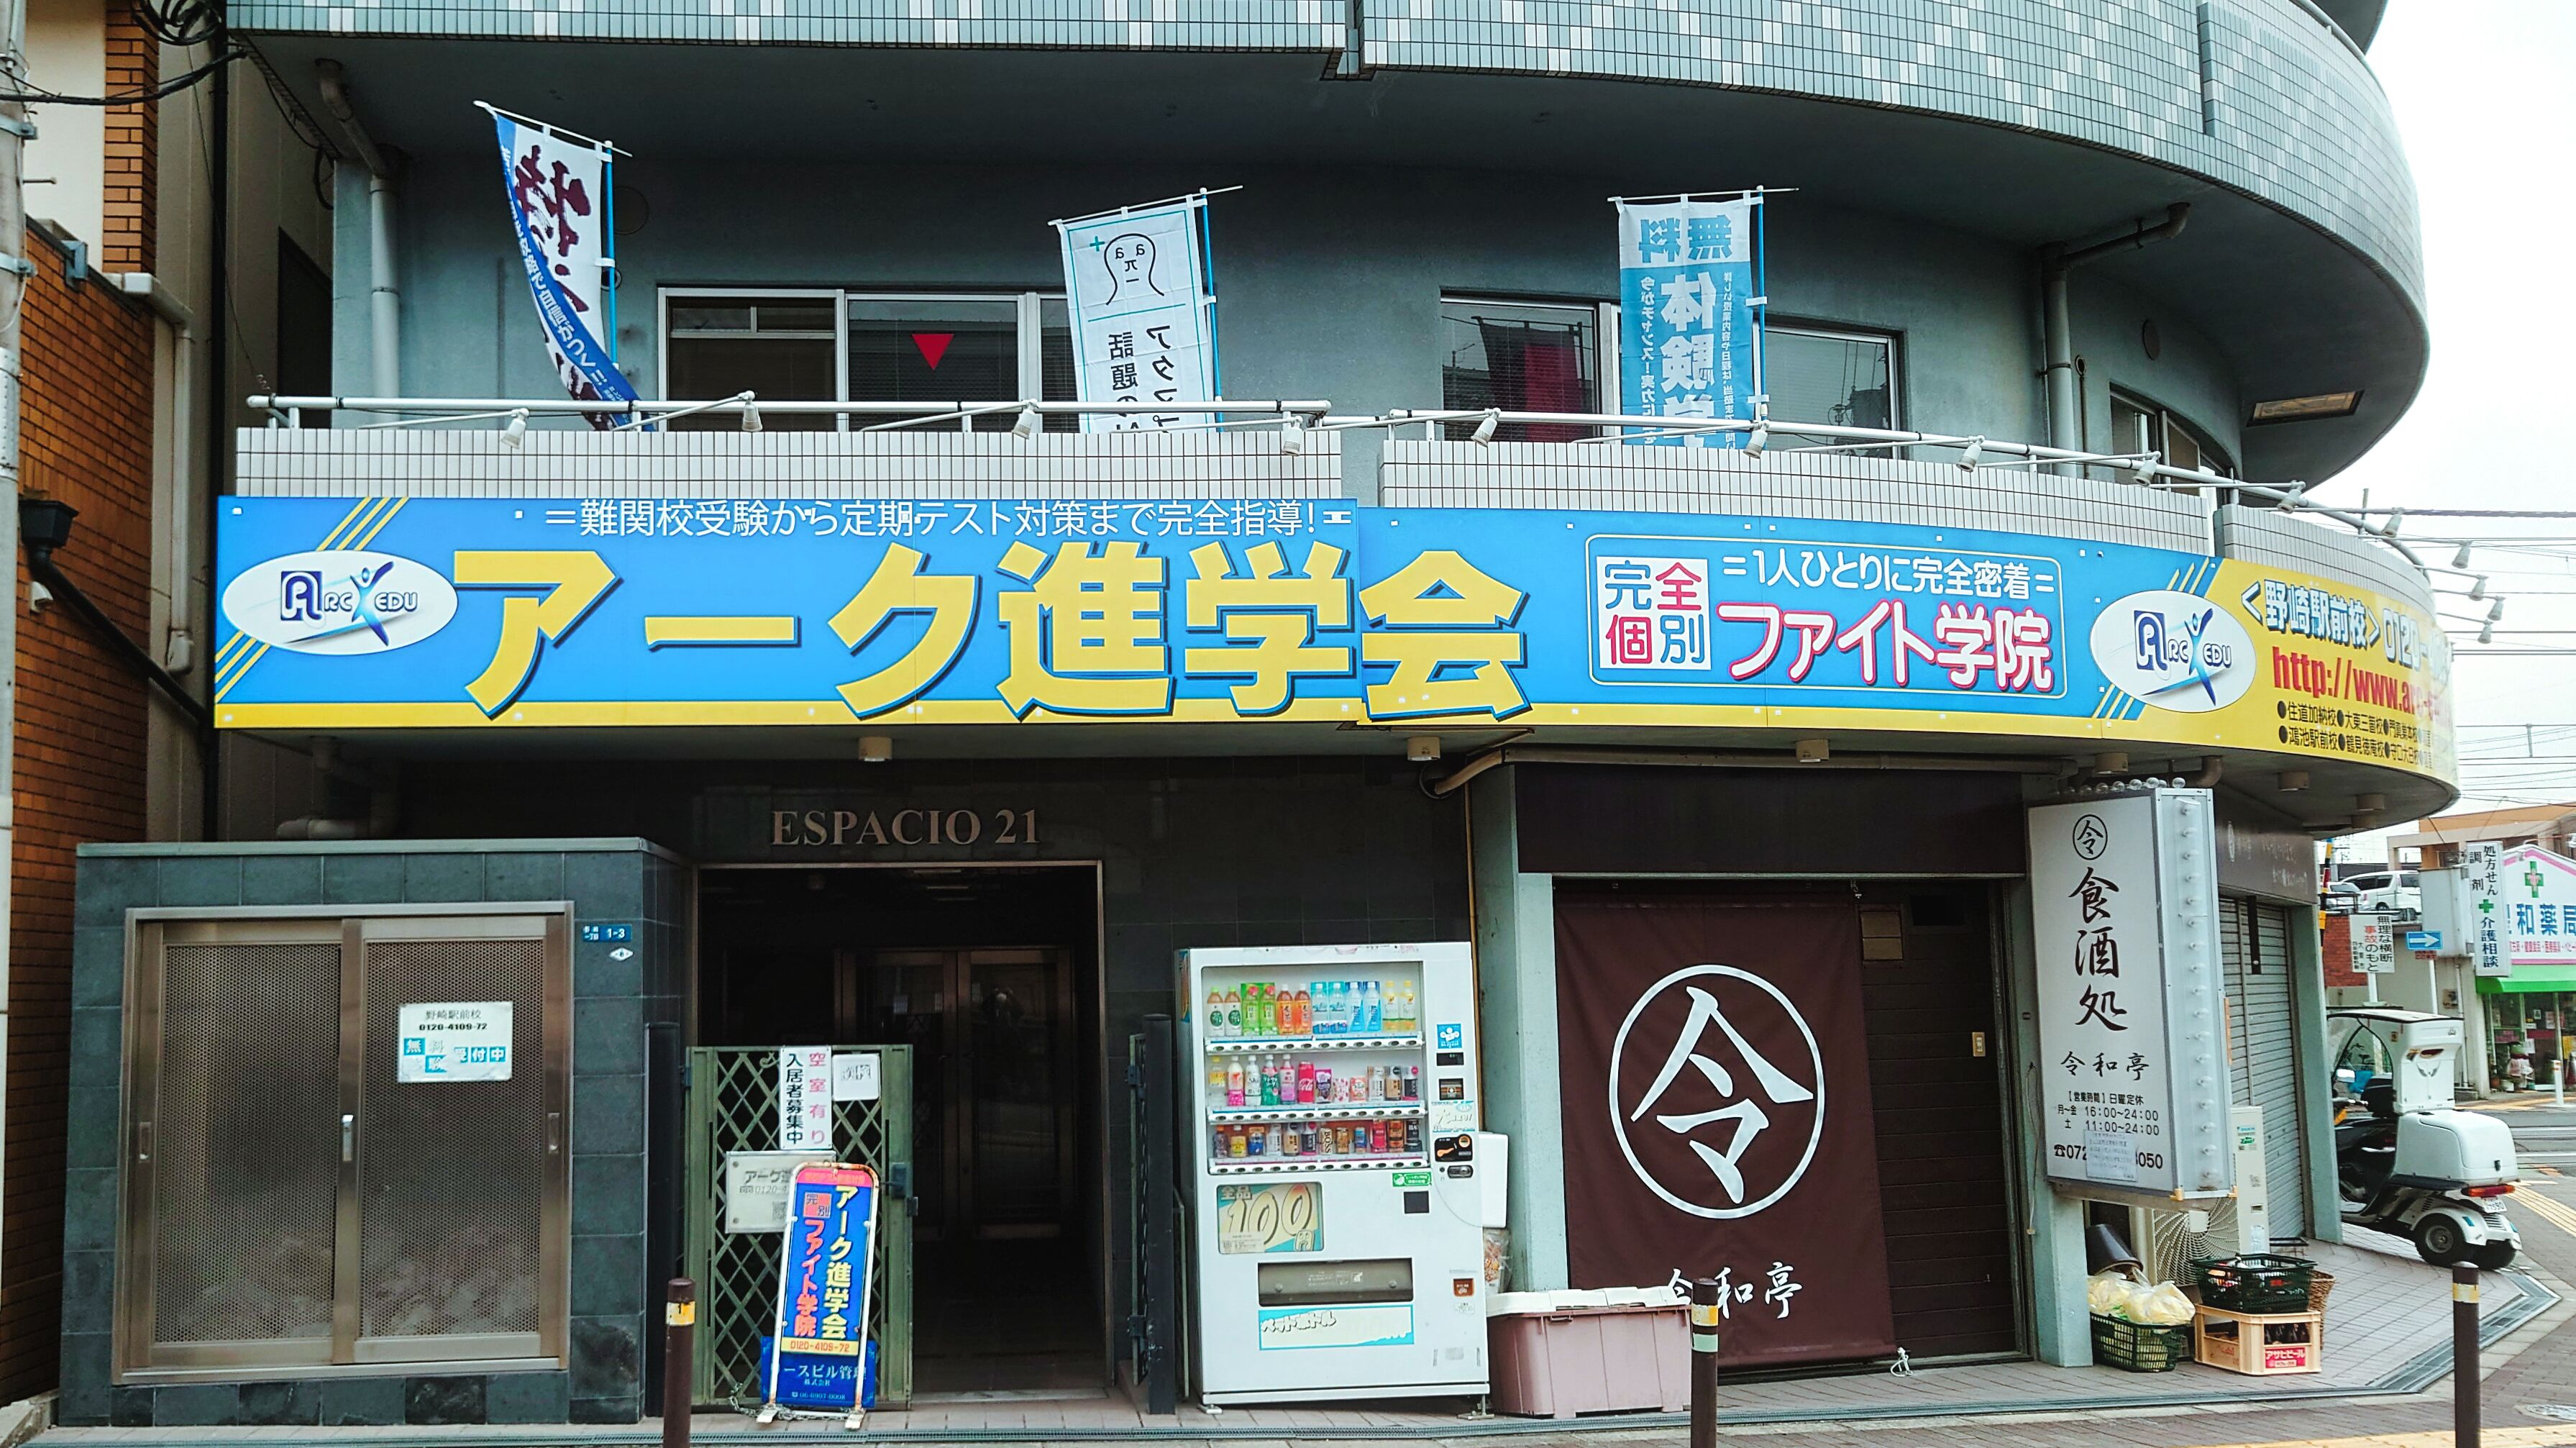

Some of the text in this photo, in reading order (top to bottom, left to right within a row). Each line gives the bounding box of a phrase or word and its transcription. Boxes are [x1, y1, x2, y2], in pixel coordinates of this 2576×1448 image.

[1604, 559, 1703, 611] 完全
[454, 541, 1530, 721] アーク進学会
[1605, 614, 1706, 665] 個別
[1716, 598, 2054, 692] ファイト学院
[772, 809, 1040, 847] ESPACIO 21
[2469, 851, 2484, 891] 調剤
[2483, 845, 2498, 896] 処方せん
[2377, 916, 2393, 962] 無理な横断
[2480, 916, 2499, 968] 介護相談
[2506, 903, 2576, 936] 和薬局
[2068, 867, 2129, 1032] 食酒処
[2364, 925, 2380, 973] 事故のもと
[419, 1022, 488, 1031] 0120-4109-72
[2060, 1050, 2150, 1081] 令和亭
[785, 1052, 805, 1145] 入居者募集中
[808, 1051, 828, 1145] 空室有り
[1630, 985, 1814, 1205] 令
[2109, 1093, 2145, 1106] 日曜定休
[794, 1219, 824, 1337] ファイト学院
[822, 1185, 859, 1341] アーク進学会
[790, 1339, 851, 1353] 0120-4109-72
[2265, 1349, 2306, 1360] アサヒビール
[778, 1364, 866, 1380] ースビル管
